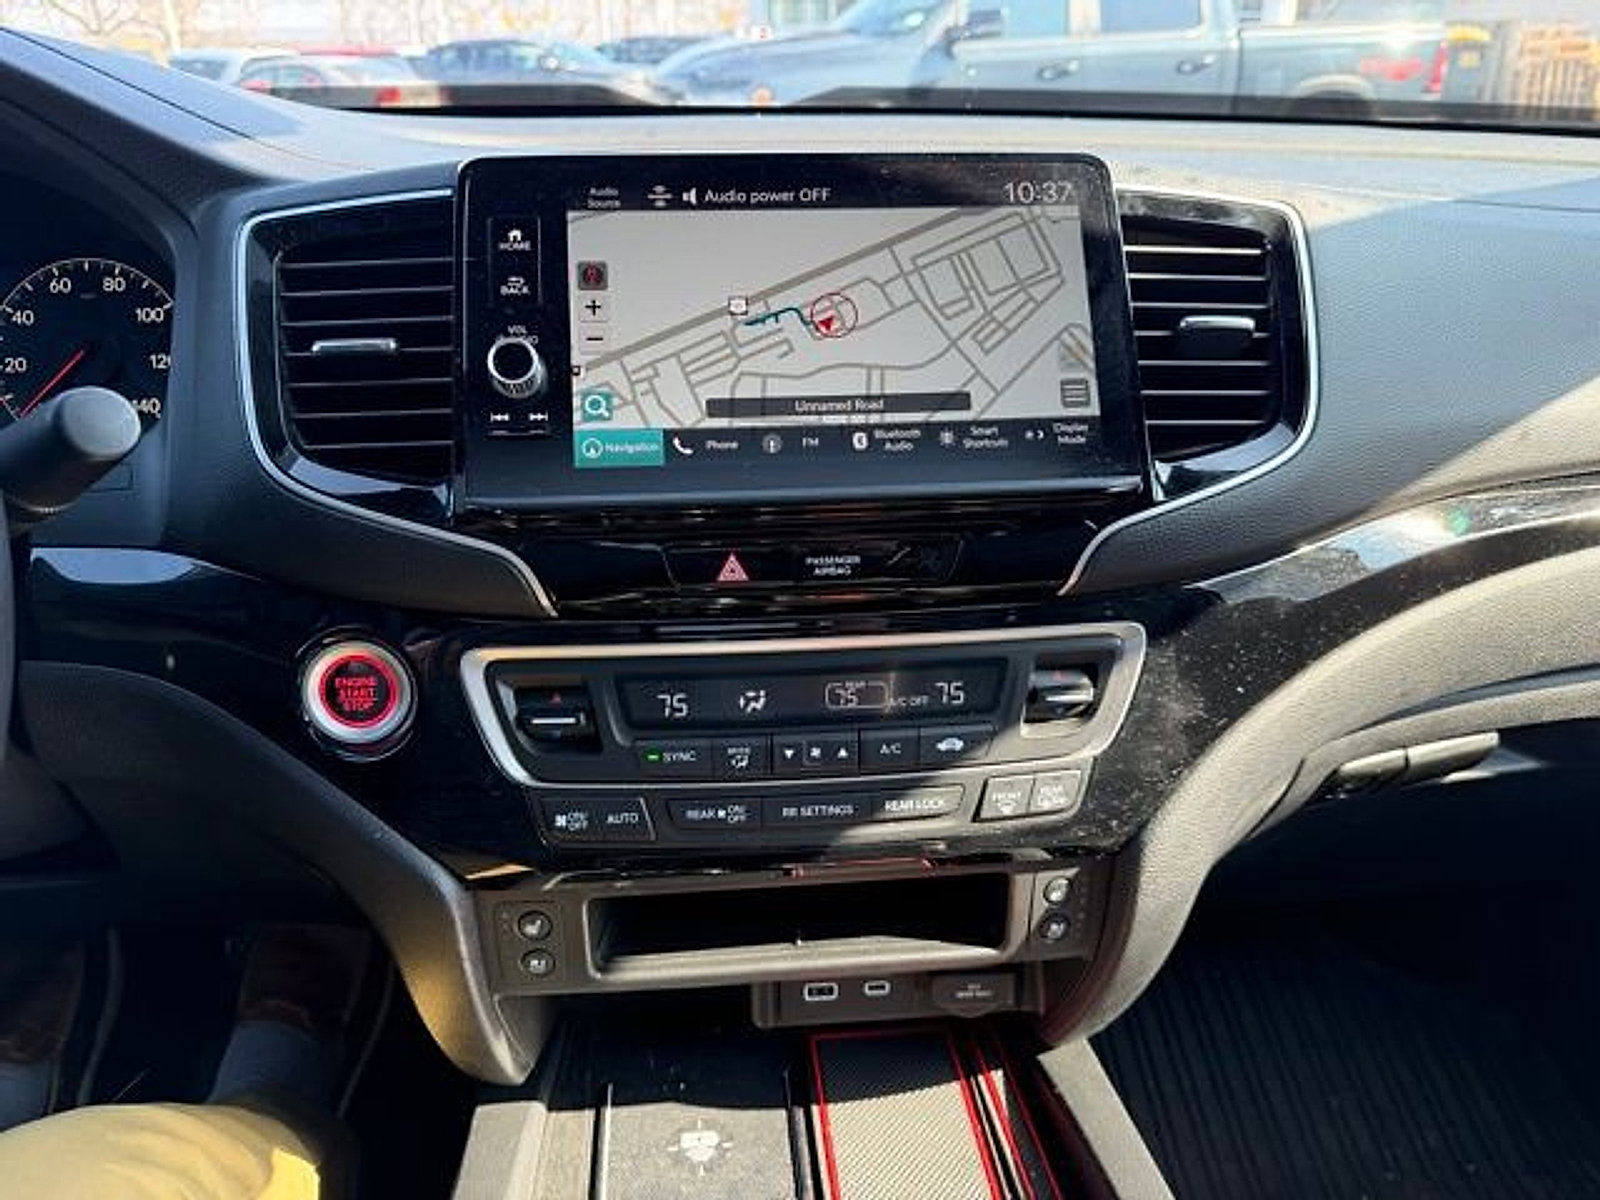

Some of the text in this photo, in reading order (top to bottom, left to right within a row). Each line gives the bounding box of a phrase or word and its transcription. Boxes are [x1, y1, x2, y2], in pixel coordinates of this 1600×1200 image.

[704, 187, 831, 205] Audio power OFF
[1003, 181, 1074, 203] 10:37
[500, 240, 531, 251] HOME
[50, 277, 72, 294] 60
[103, 277, 127, 293] 80
[500, 284, 531, 296] BACK
[12, 310, 35, 326] 40
[135, 307, 165, 323] 100
[4, 357, 27, 373] 20
[794, 399, 884, 413] Unnamed Road
[604, 441, 660, 454] Navigation
[706, 439, 739, 450] Phone
[934, 681, 966, 705] 75
[657, 692, 690, 718] 75
[879, 742, 903, 755] A/C
[663, 751, 697, 763] SYNC
[606, 812, 640, 825] AUTO
